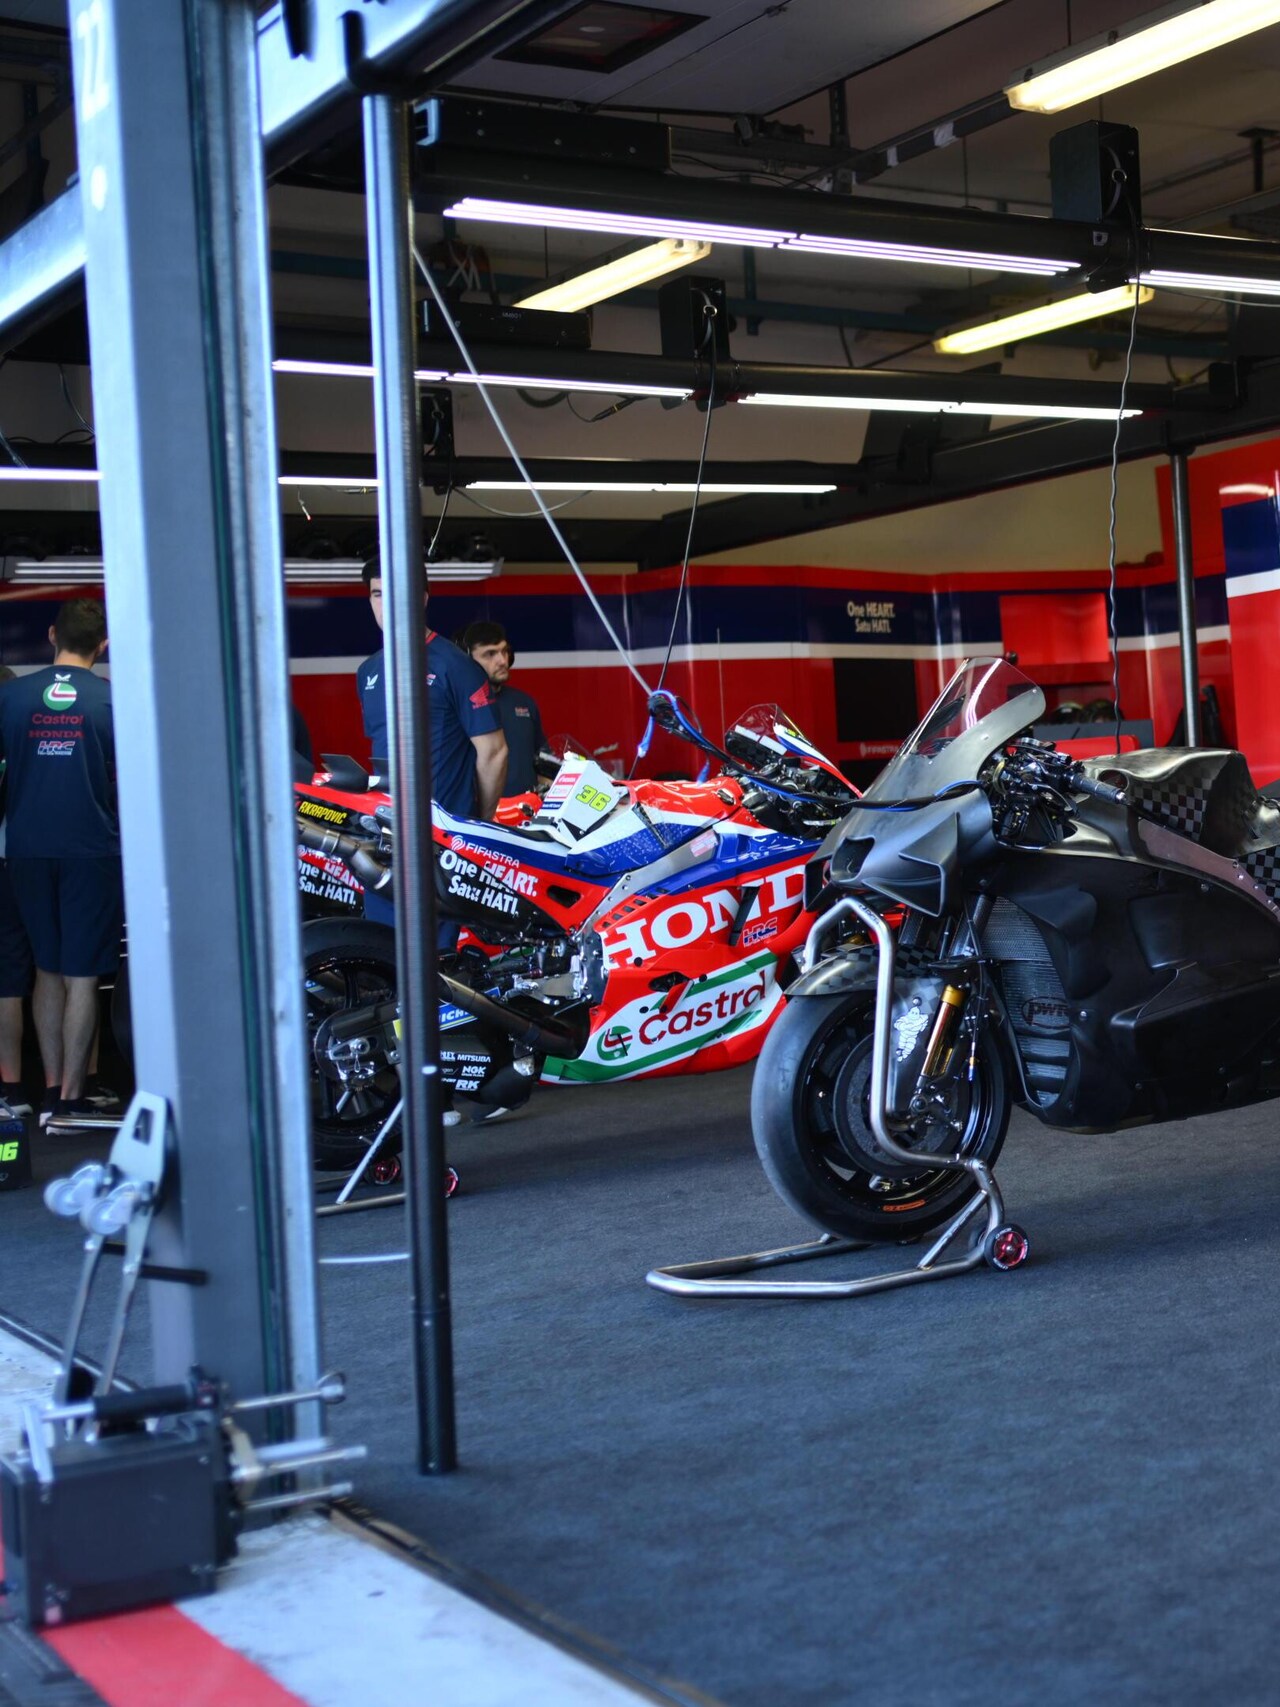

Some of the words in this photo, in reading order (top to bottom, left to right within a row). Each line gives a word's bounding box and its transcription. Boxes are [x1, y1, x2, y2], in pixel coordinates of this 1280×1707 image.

[847, 602, 865, 617] One
[855, 619, 871, 632] Satu
[32, 713, 84, 725] Castrol
[28, 730, 84, 738] HONDA
[576, 785, 612, 812] 36
[466, 842, 520, 868] FIFASTRA
[440, 849, 477, 878] One
[479, 860, 539, 897] HEART.
[448, 875, 481, 902] Satu
[481, 887, 519, 916] HATI.
[743, 917, 778, 948] HRC
[457, 1054, 491, 1063] MITSUBA
[462, 1065, 487, 1075] NGK
[456, 1079, 480, 1092] RK
